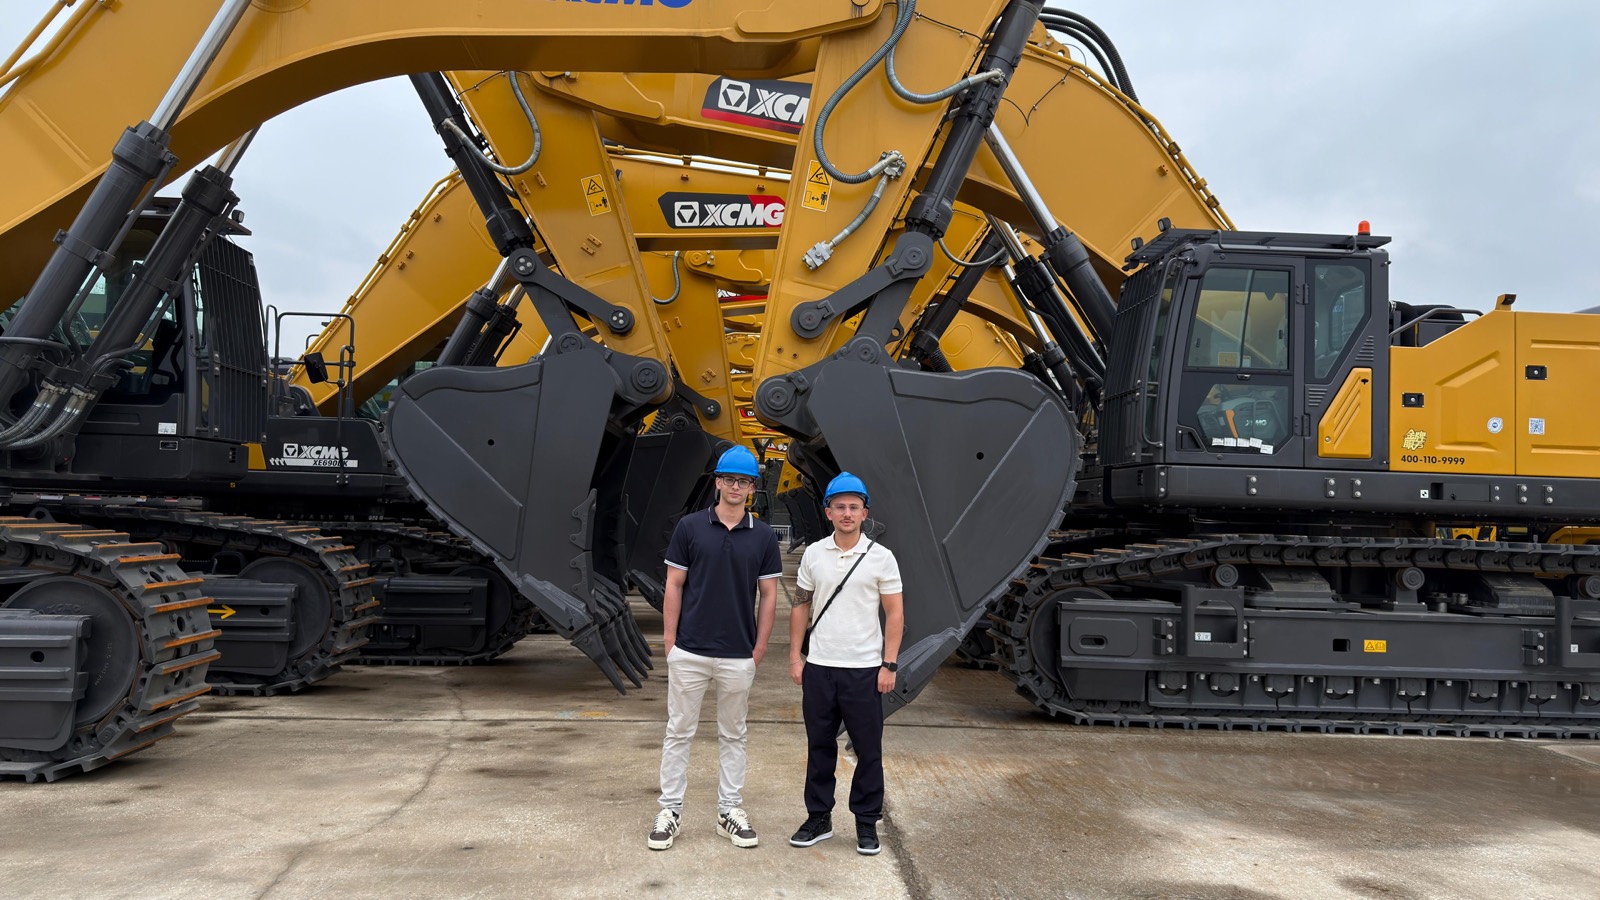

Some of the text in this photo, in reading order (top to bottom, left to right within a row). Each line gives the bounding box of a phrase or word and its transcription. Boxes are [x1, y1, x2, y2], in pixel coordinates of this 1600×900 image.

[747, 88, 810, 124] XCM
[700, 202, 785, 226] XCMG
[298, 445, 349, 459] XCMG
[1401, 455, 1465, 465] 400-110-9999
